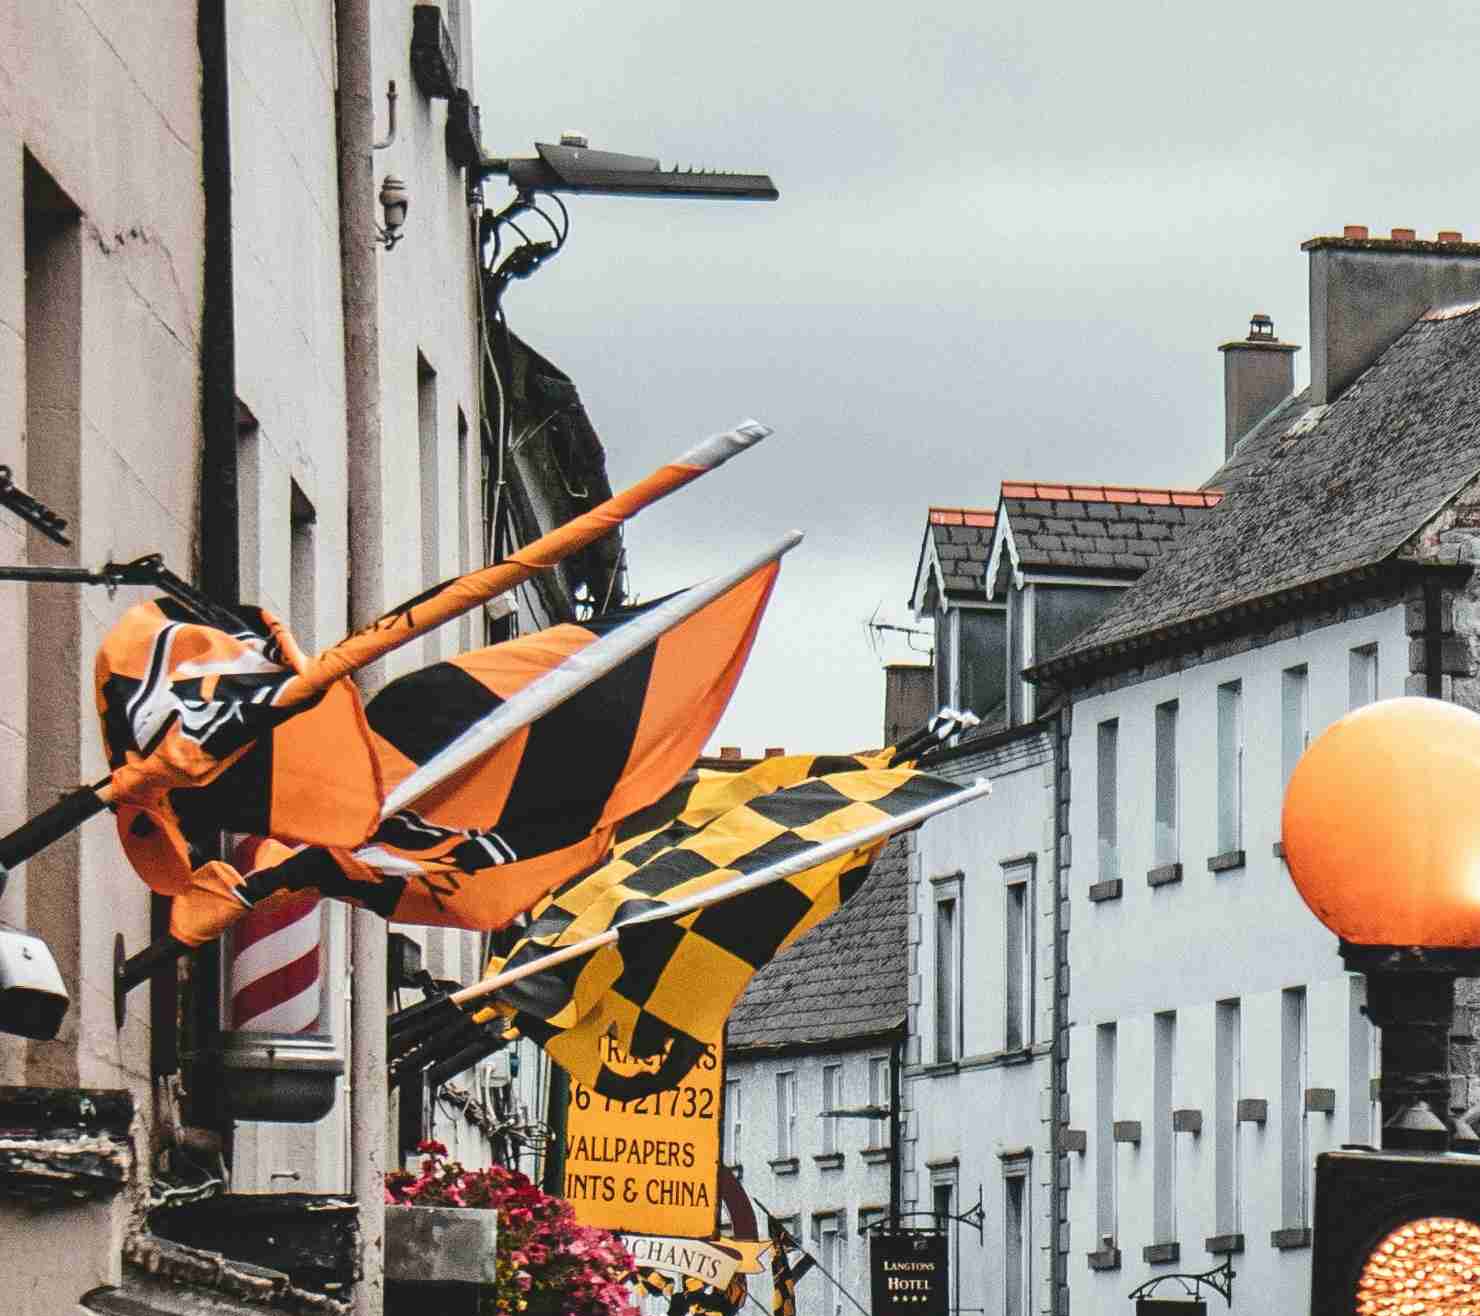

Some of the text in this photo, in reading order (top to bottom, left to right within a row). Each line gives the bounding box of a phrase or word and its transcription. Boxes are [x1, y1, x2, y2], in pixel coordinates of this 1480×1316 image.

[567, 1083, 590, 1111] 6
[567, 1173, 710, 1208] INTS & CHINA
[622, 1238, 722, 1278] CHANTS
[888, 1276, 932, 1291] HOTEL
